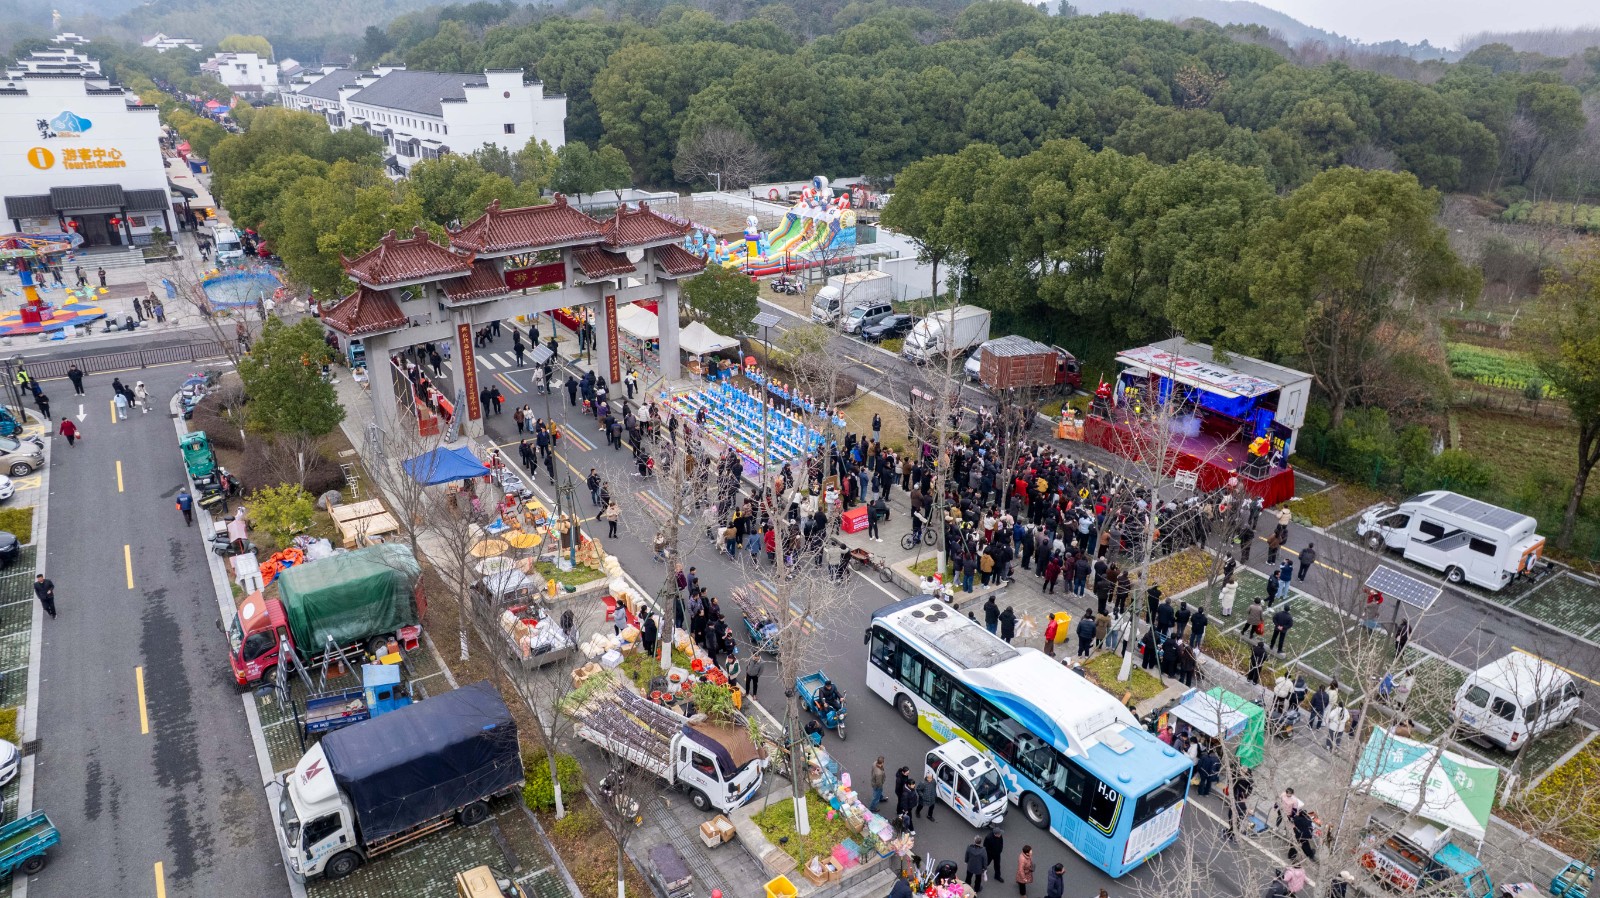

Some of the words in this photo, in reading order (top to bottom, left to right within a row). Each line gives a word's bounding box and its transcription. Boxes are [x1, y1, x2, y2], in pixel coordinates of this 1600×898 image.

[61, 147, 122, 161] 游客中心
[62, 160, 96, 170] Tourist
[98, 159, 127, 169] Centre
